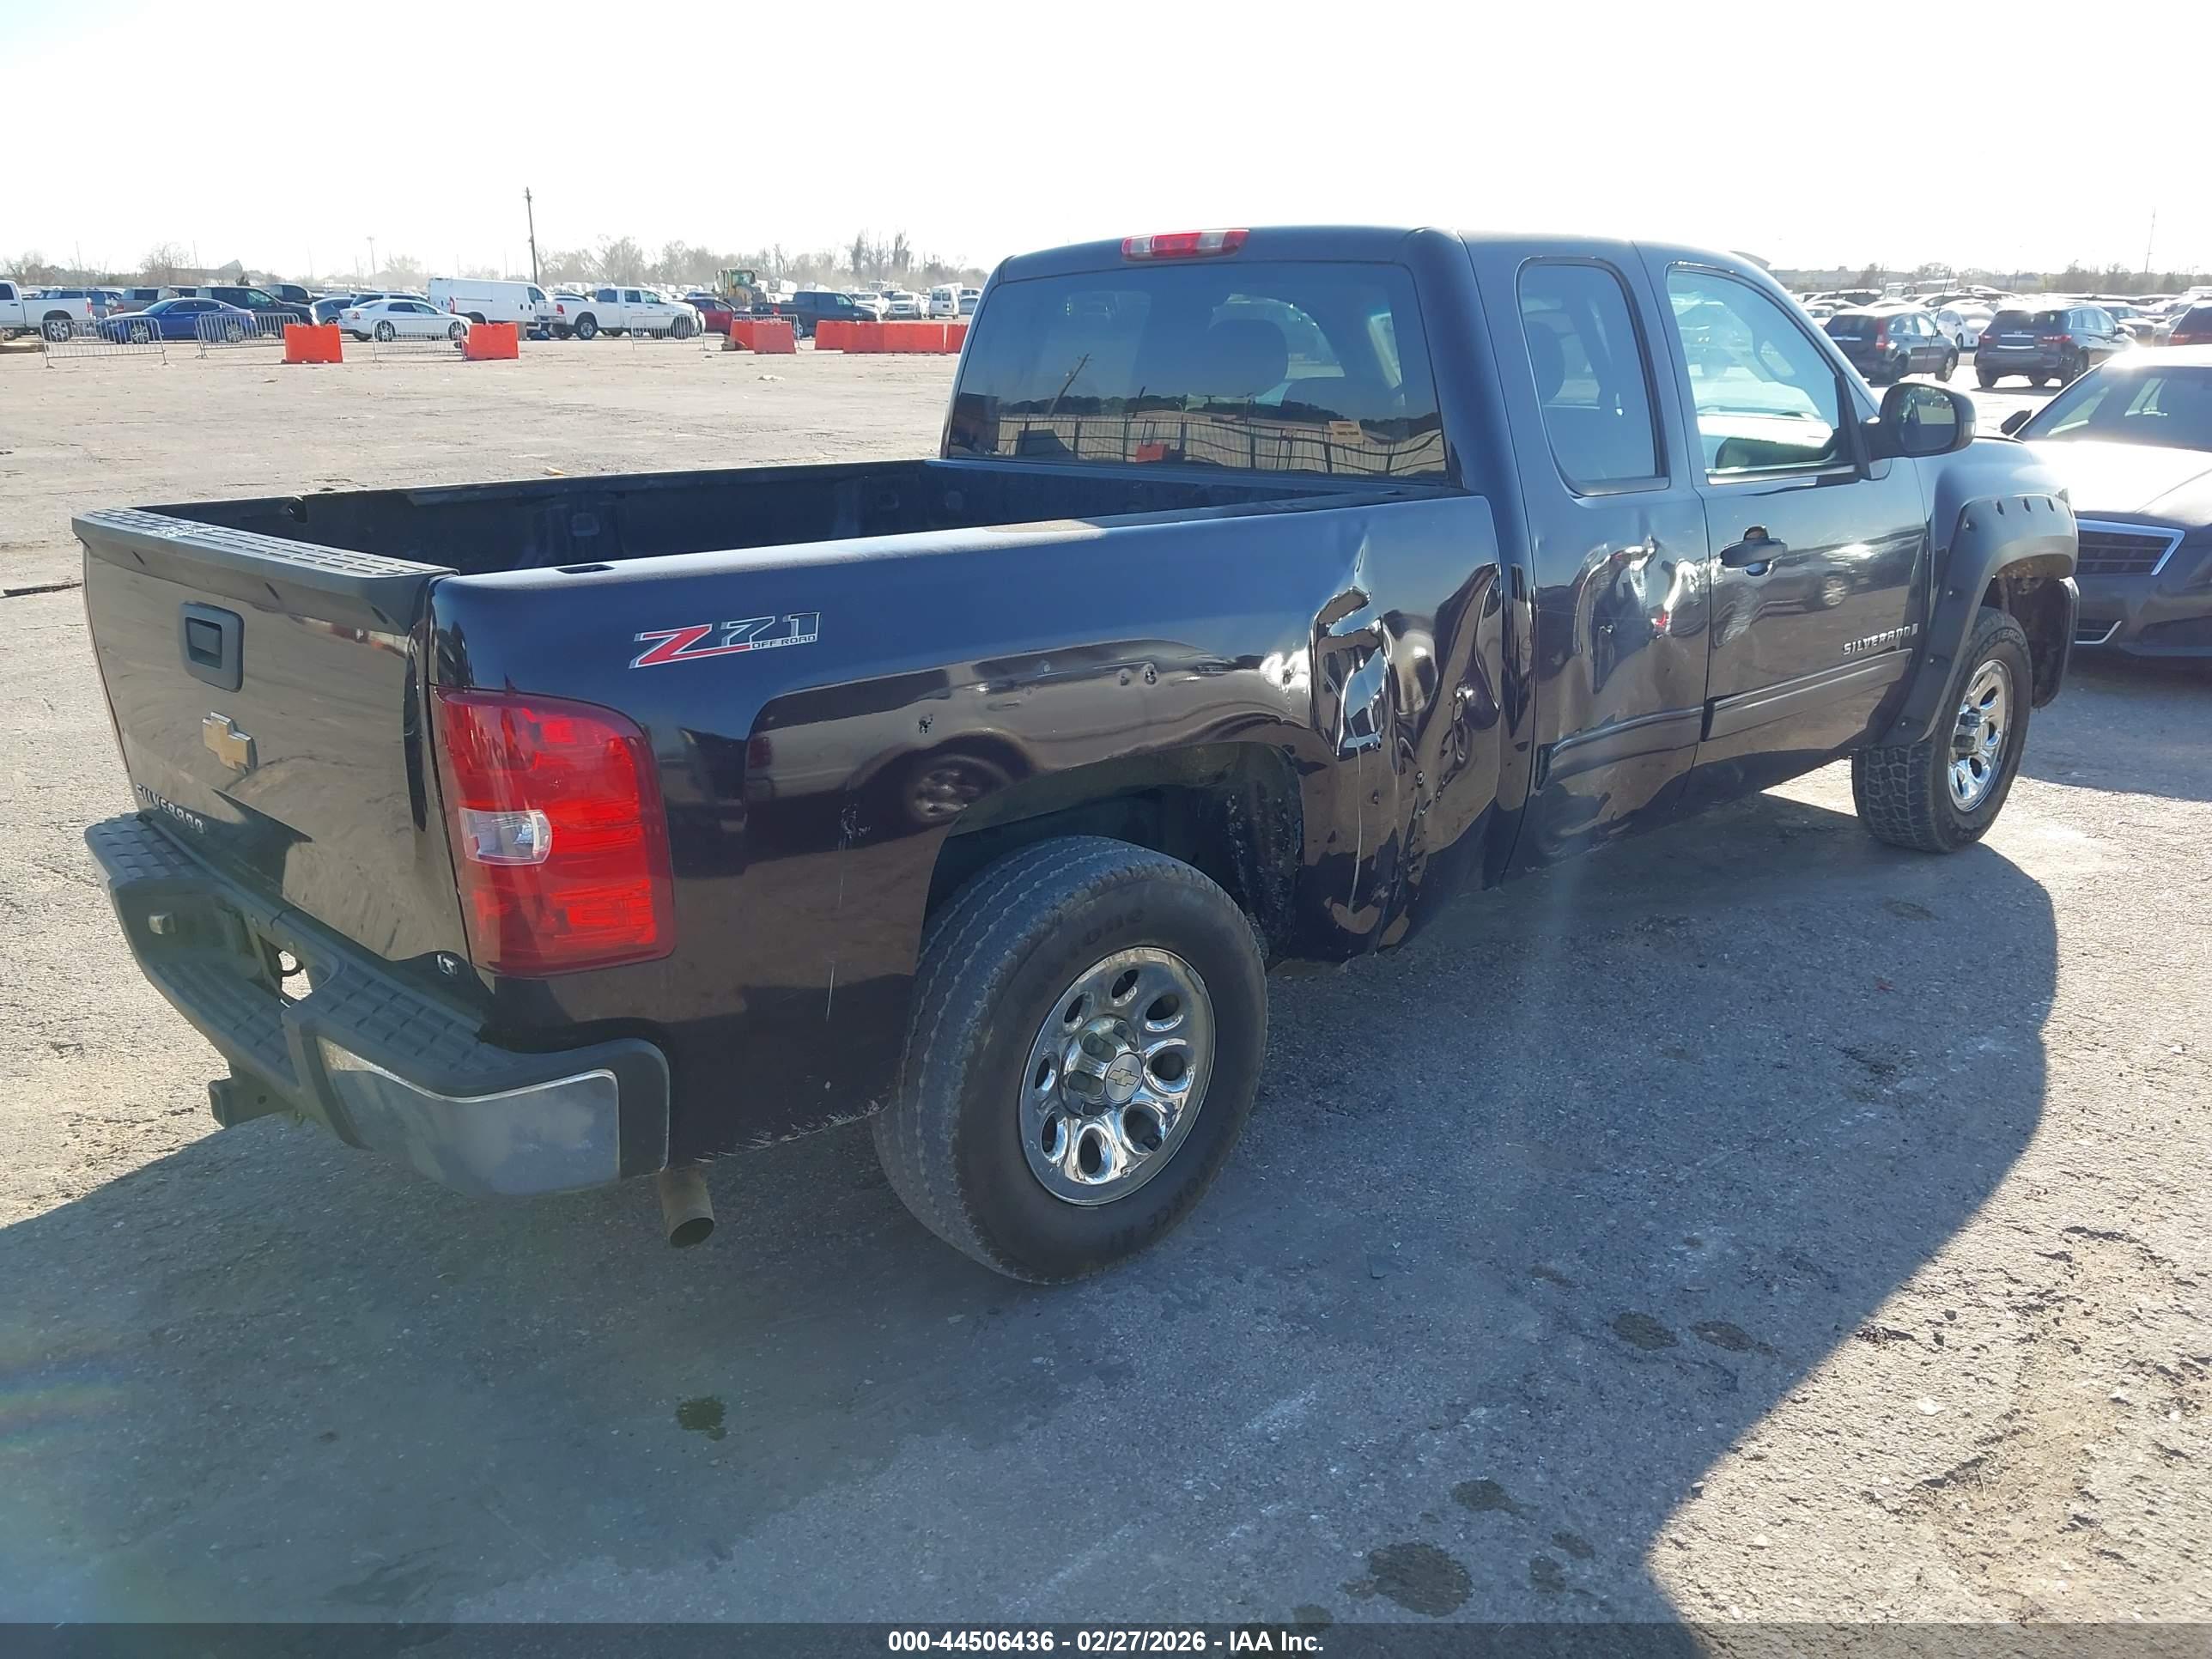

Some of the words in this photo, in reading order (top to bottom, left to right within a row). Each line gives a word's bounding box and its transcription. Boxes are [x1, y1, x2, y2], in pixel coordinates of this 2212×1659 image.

[629, 612, 821, 669] Z71
[752, 640, 777, 649] OFF
[781, 635, 816, 645] ROAD
[436, 954, 455, 976] LT
